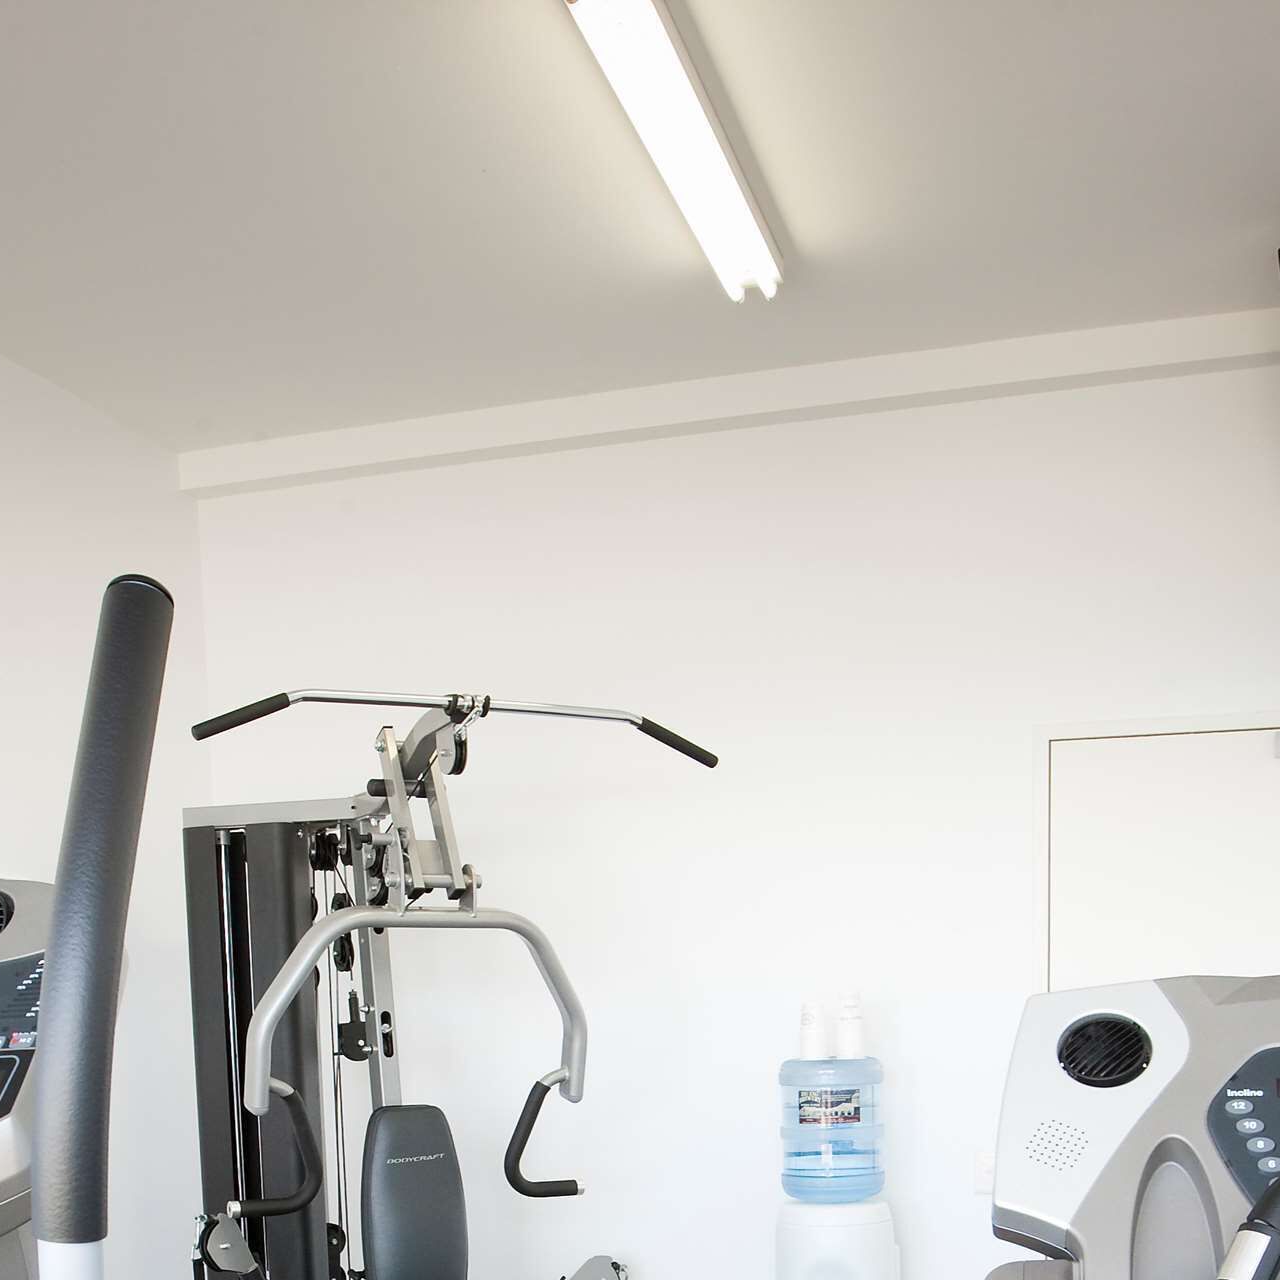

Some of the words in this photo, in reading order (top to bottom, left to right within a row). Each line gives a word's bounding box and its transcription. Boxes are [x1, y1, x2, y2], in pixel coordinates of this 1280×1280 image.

[1226, 1088, 1265, 1098] Incline
[1231, 1101, 1246, 1110] 12
[1243, 1121, 1257, 1130] 10
[1256, 1140, 1265, 1149] 8
[1267, 1160, 1276, 1169] 6
